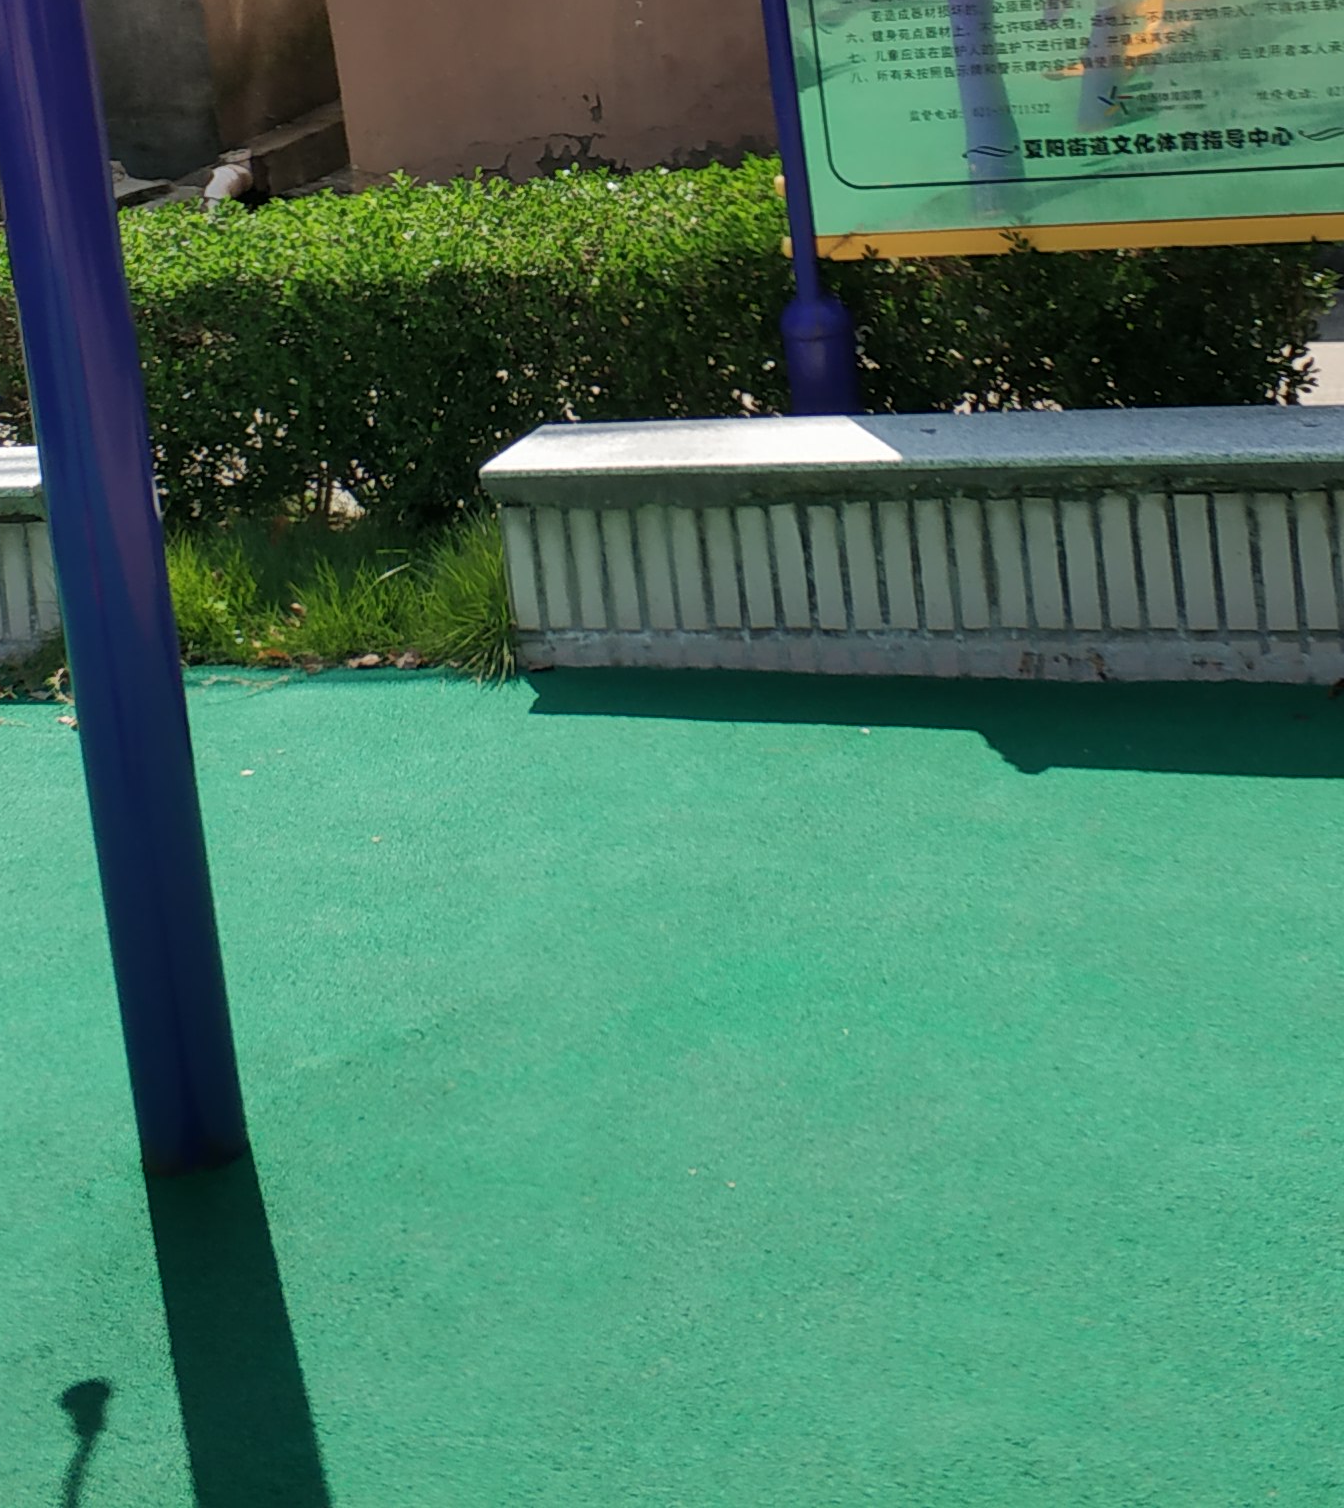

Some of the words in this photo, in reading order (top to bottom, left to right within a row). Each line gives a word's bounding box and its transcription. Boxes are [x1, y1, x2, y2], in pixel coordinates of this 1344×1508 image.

[1022, 124, 1293, 161] 夏阳街道文化体育指导中心
